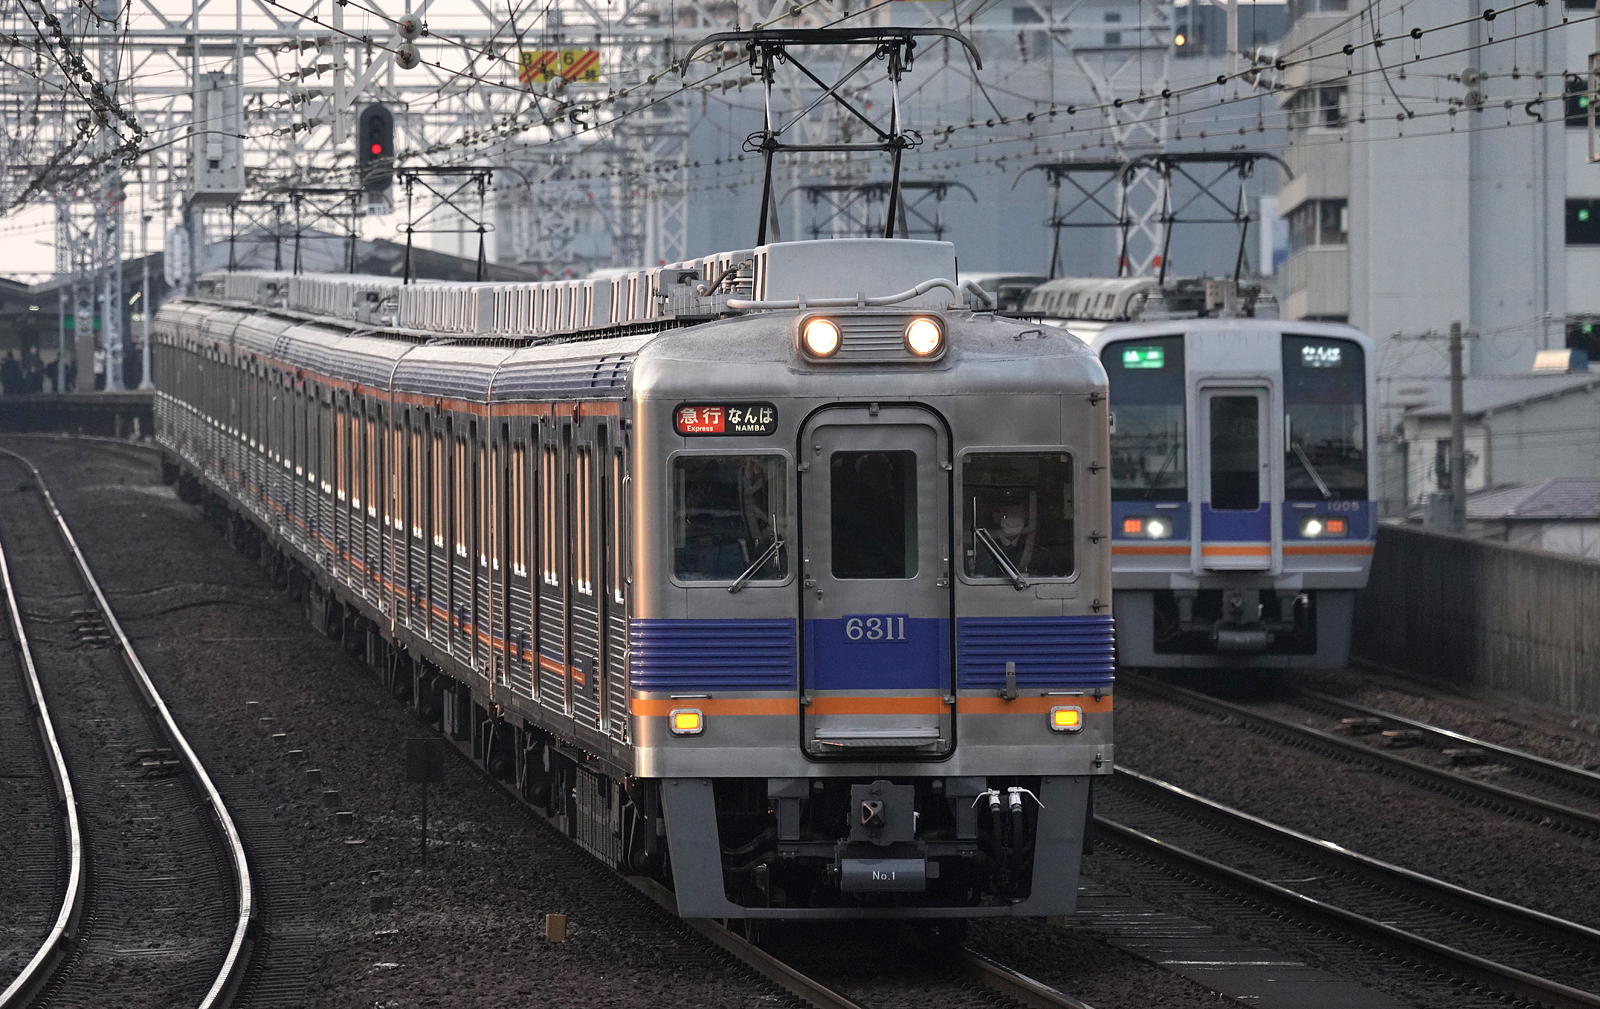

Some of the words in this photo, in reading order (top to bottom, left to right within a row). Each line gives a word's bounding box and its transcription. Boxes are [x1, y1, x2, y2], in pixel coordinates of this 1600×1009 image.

[563, 51, 574, 65] 6
[680, 407, 721, 424] 急行
[728, 407, 773, 424] なんば
[735, 424, 766, 432] NAMBA
[846, 617, 906, 640] 6311
[872, 870, 896, 880] No.1
